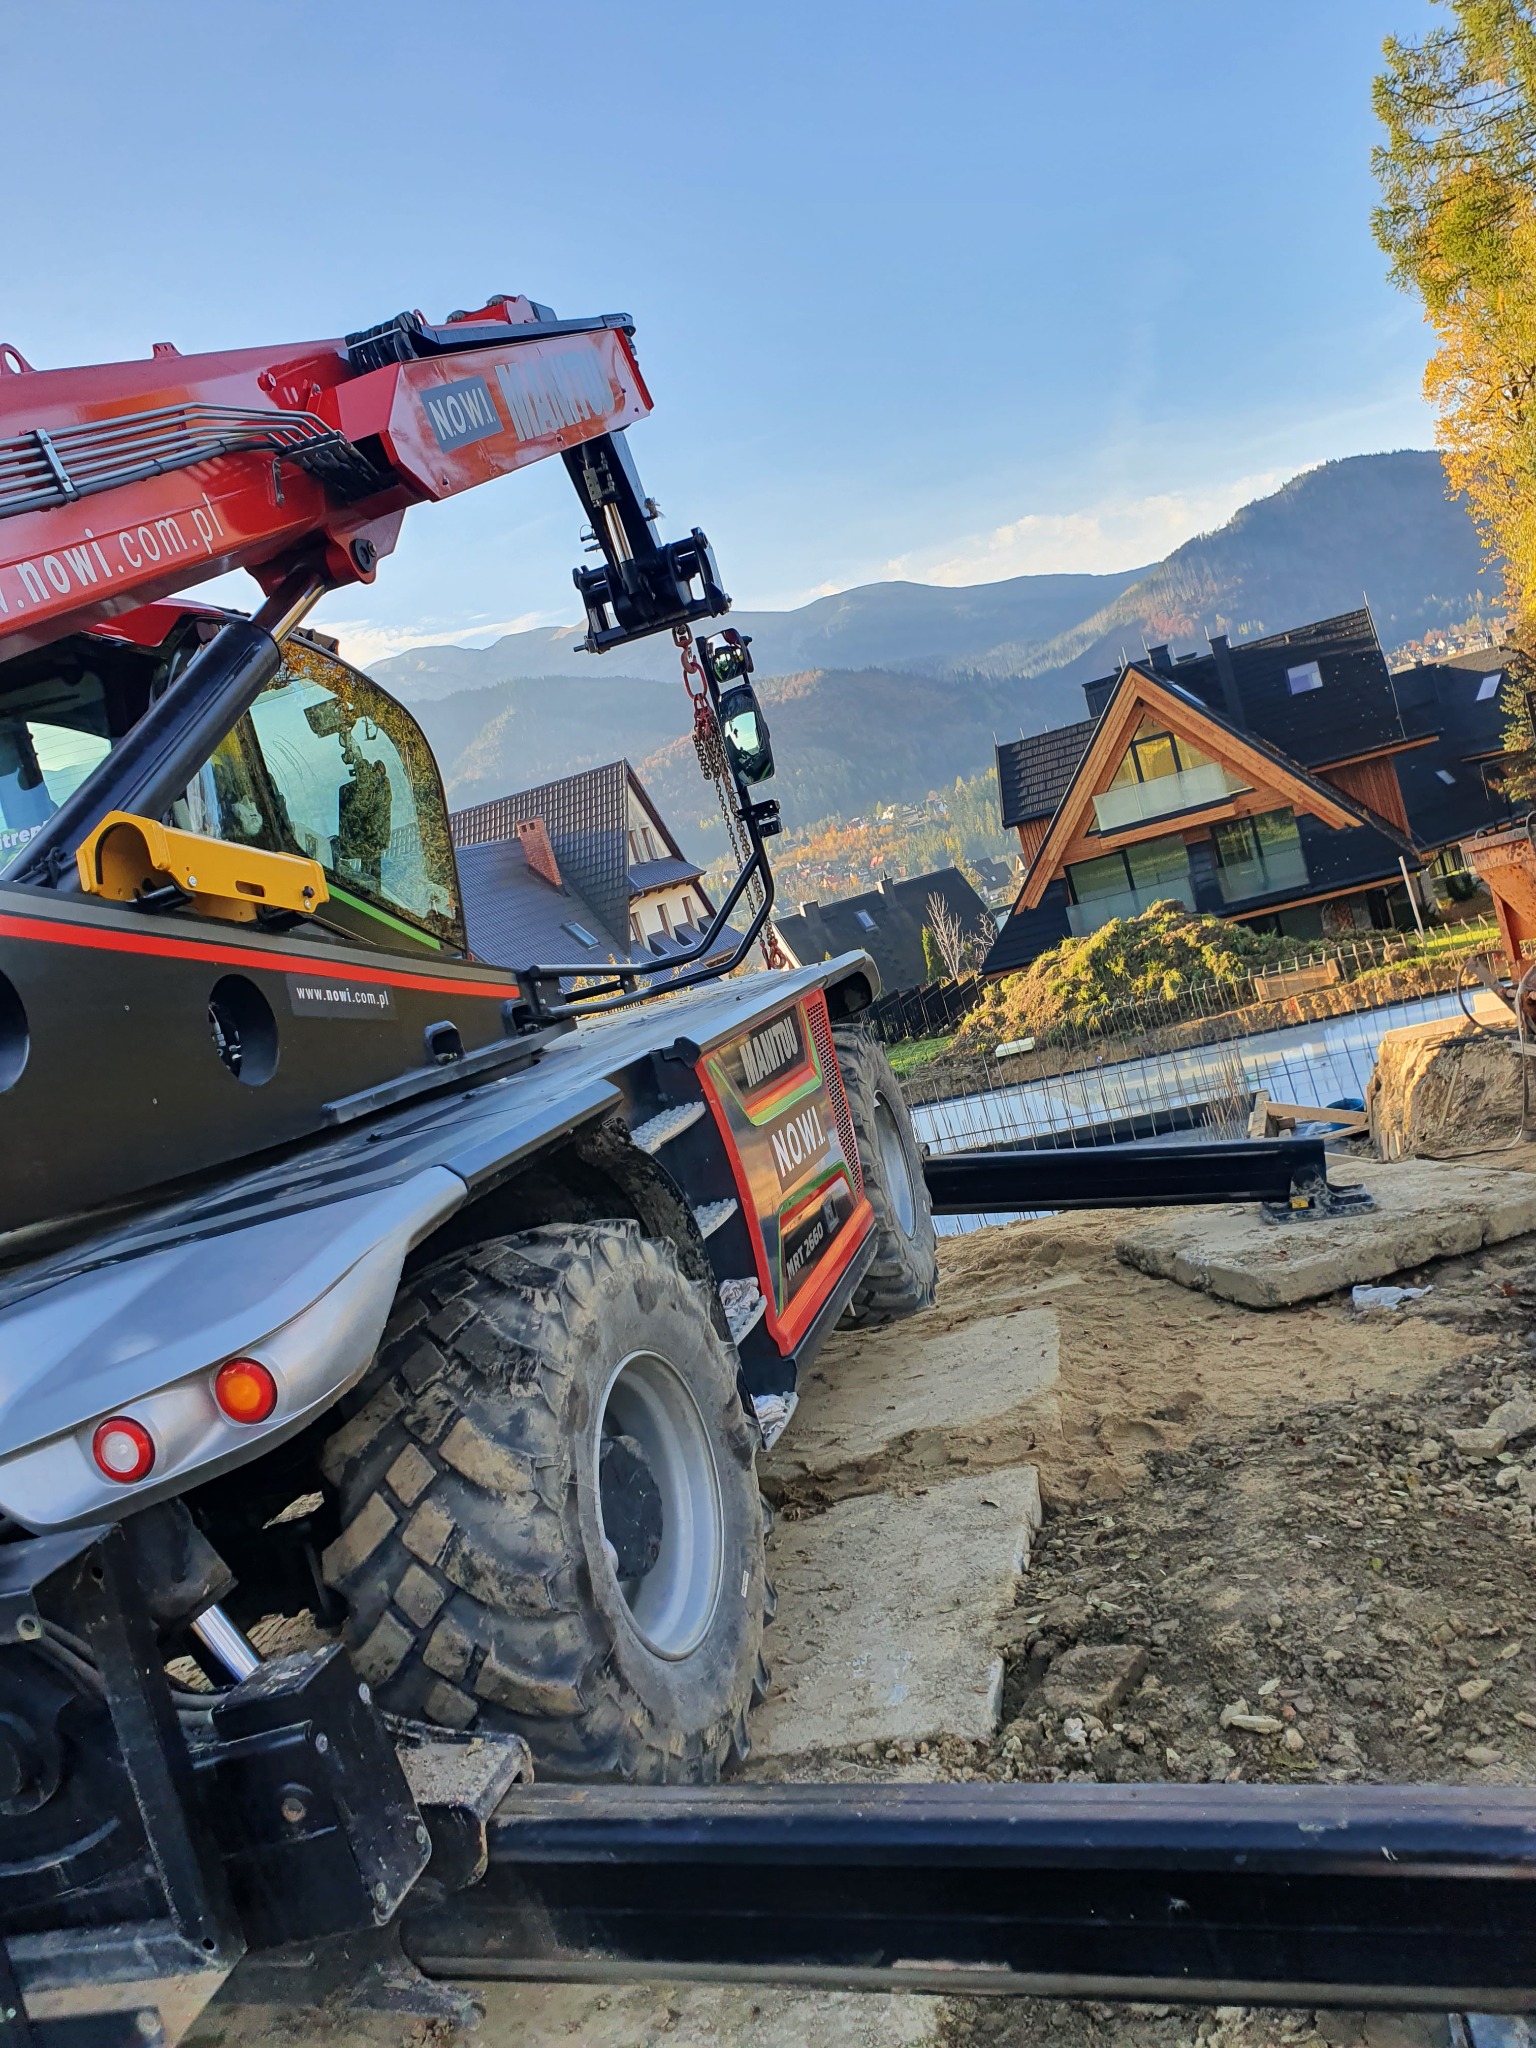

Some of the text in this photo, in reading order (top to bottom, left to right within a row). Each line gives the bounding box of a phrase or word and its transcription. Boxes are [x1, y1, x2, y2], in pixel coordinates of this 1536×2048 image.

[428, 386, 496, 441] N.O.W.I.
[296, 987, 389, 1008] www.nowi.com.pl
[739, 1016, 798, 1088] MANITOU
[771, 1105, 826, 1178] N.O.W.I.
[786, 1221, 824, 1280] MRT 2660
